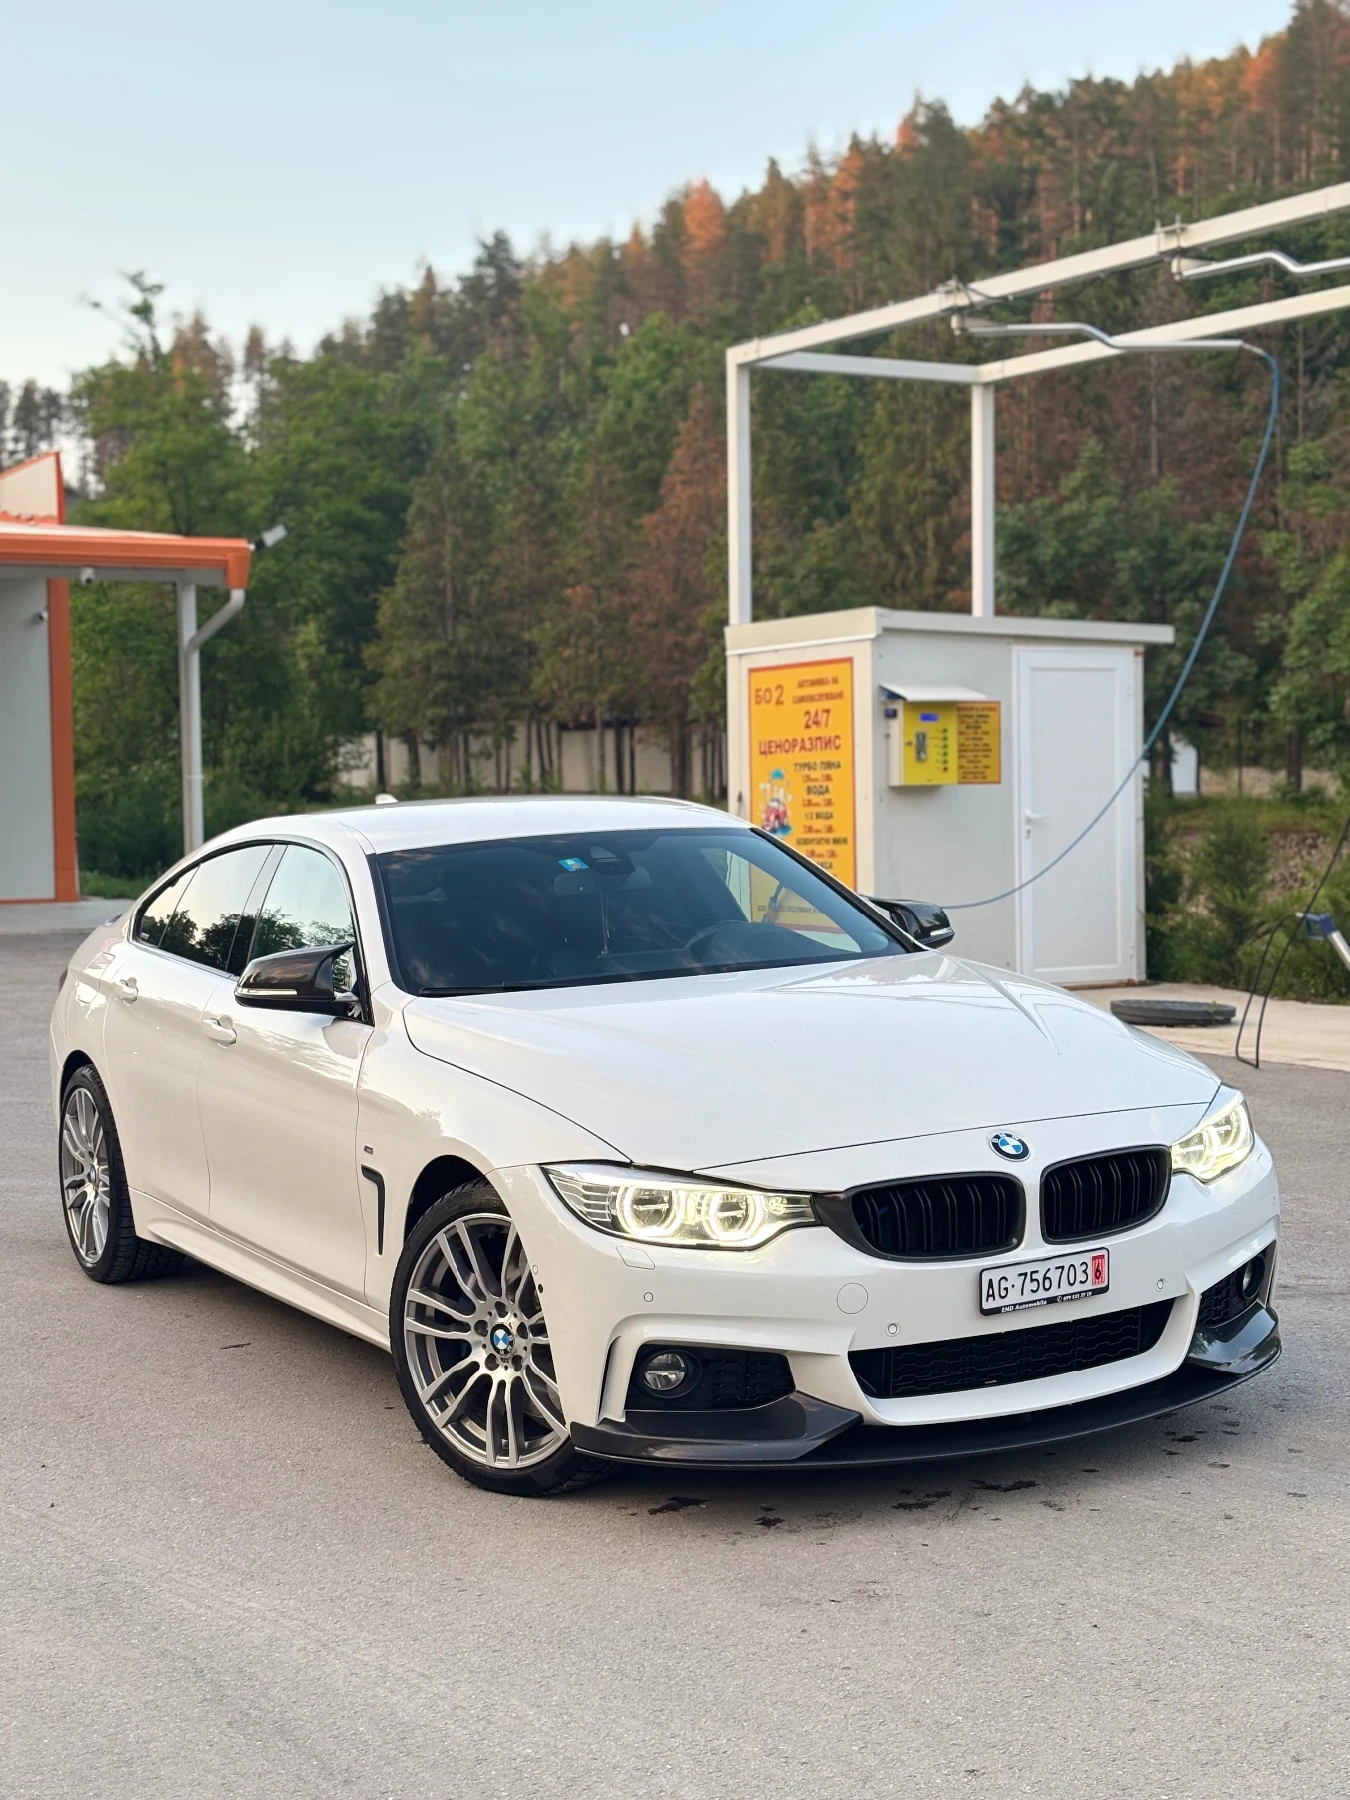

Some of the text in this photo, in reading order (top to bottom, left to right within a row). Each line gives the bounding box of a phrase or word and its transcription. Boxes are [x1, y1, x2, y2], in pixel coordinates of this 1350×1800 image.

[804, 708, 831, 729] 24/7
[758, 735, 841, 757] ЦЕНОРАЗПИС
[806, 784, 829, 796] ВОДА
